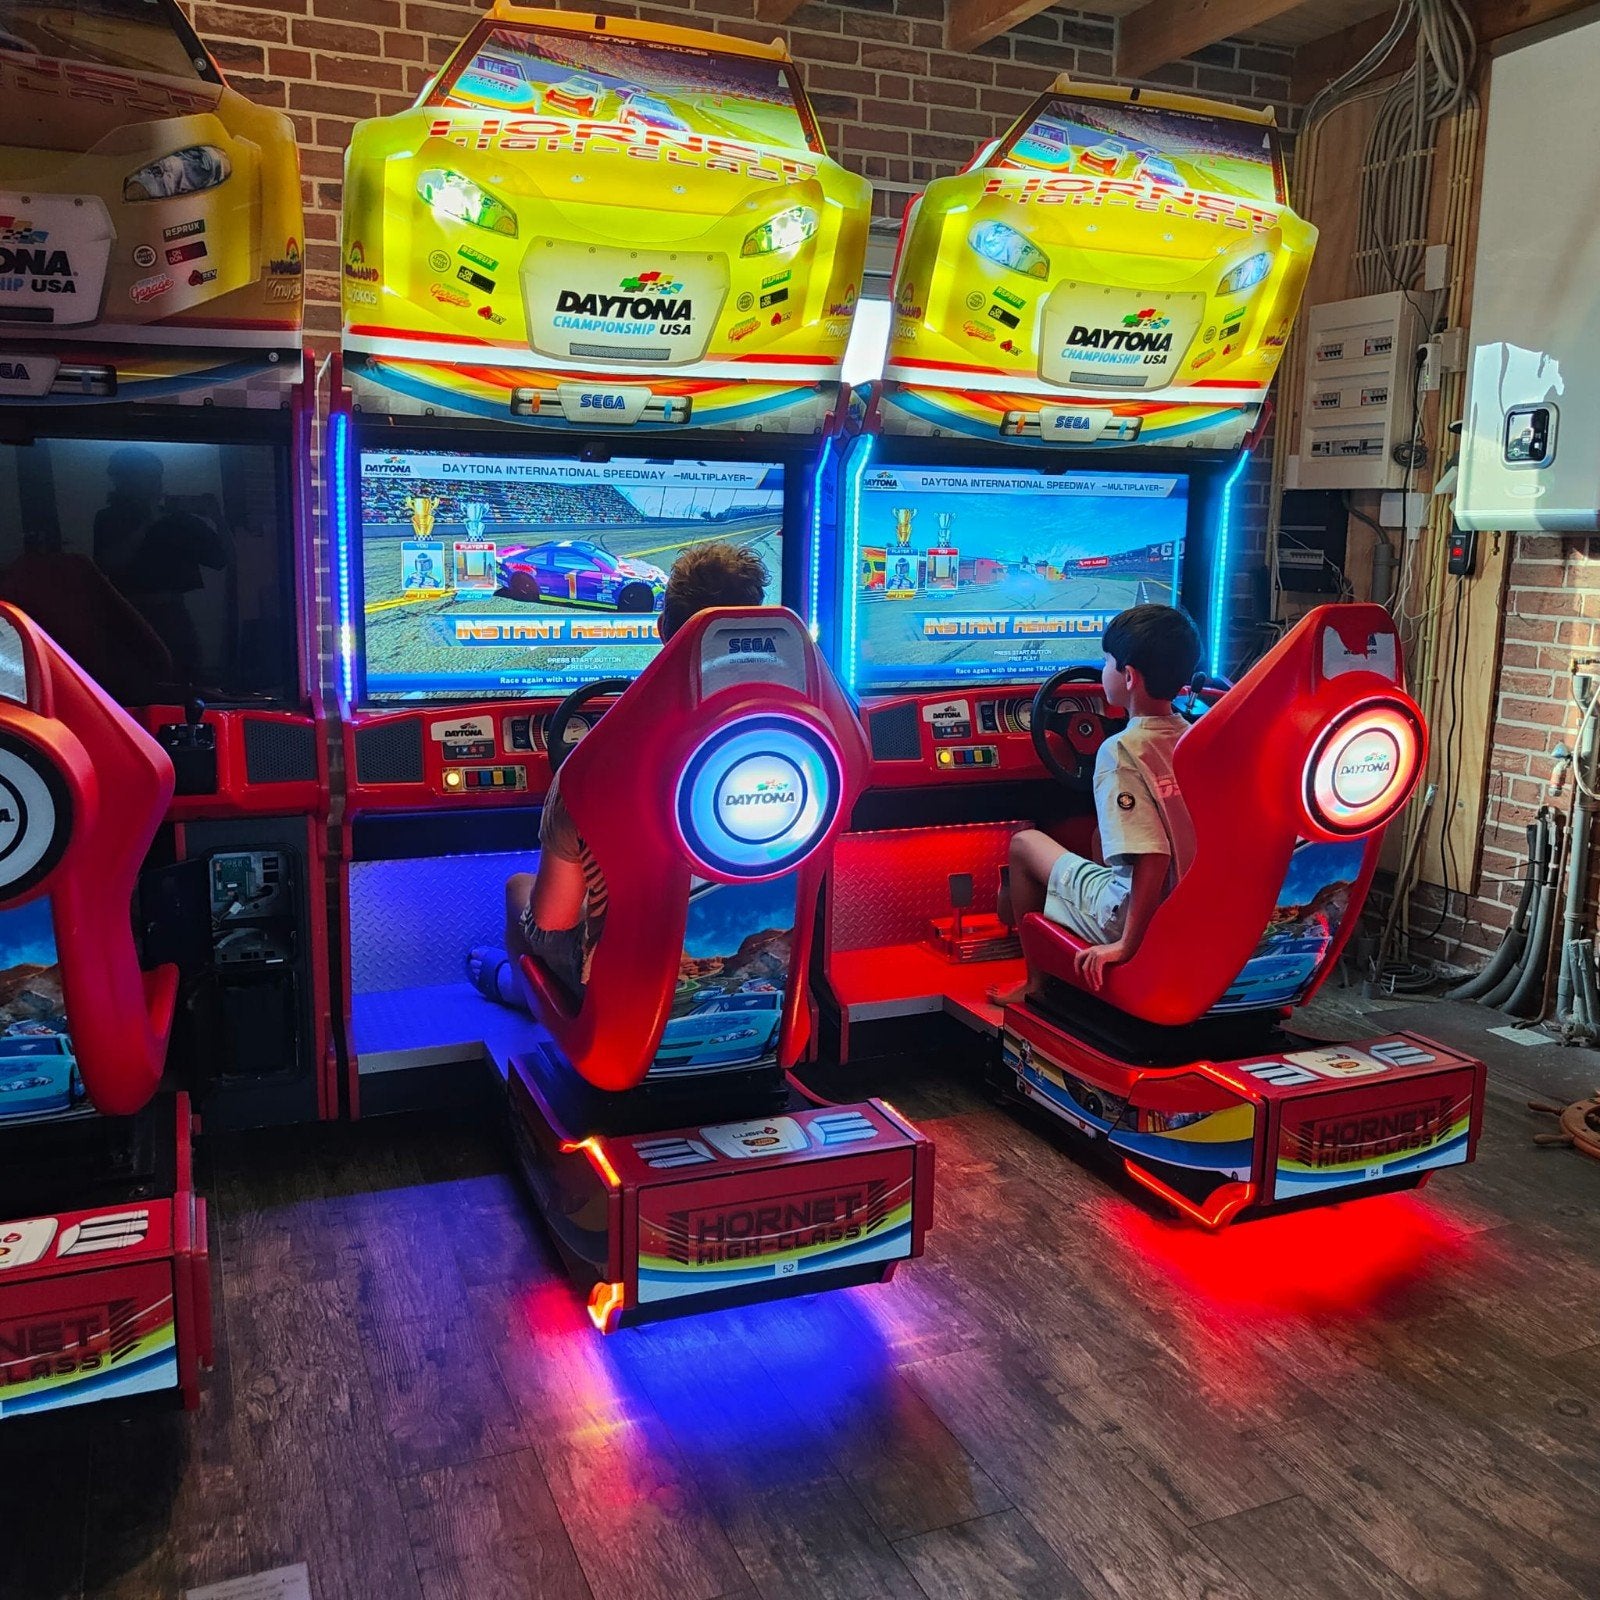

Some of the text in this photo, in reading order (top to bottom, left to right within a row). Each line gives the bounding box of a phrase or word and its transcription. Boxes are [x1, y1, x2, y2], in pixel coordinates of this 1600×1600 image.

[428, 118, 818, 175] HORNET
[984, 178, 1278, 223] HORNET
[31, 280, 76, 294] USA
[555, 289, 692, 321] DAYTONA
[553, 315, 691, 336] CHAMPIONSHIP USA
[1065, 325, 1173, 352] DAYTONA
[1061, 347, 1168, 365] CHAMPIONSHIP USA
[580, 394, 625, 410] SEGA
[1054, 415, 1090, 430] SEGA
[364, 464, 412, 474] DAYTONA
[442, 463, 502, 475] DAYTONA
[506, 466, 601, 478] INTERNATIONAL
[603, 469, 666, 480] SPEEDWAY
[921, 477, 969, 487] DAYTONA
[970, 478, 1045, 489] INTERNATIONAL
[1047, 480, 1096, 490] SPEEDWAY
[565, 571, 578, 599] 1
[455, 619, 566, 640] INSTANT
[923, 616, 1010, 635] INSTANT
[728, 637, 777, 654] SEGA
[500, 676, 520, 684] Race
[522, 677, 544, 686] again
[546, 675, 563, 683] with
[565, 675, 578, 683] the
[972, 668, 990, 676] again
[444, 729, 483, 738] DAYTONA
[1339, 761, 1390, 775] DAYTONA
[725, 791, 795, 806] DAYTONA
[1318, 1105, 1436, 1146] HORNET
[1317, 1133, 1434, 1168] HIGH-CLASS
[1370, 1168, 1379, 1177] 54
[697, 1193, 863, 1241] HORNET
[696, 1226, 863, 1266] HIGH-CLASS
[782, 1263, 795, 1274] 52
